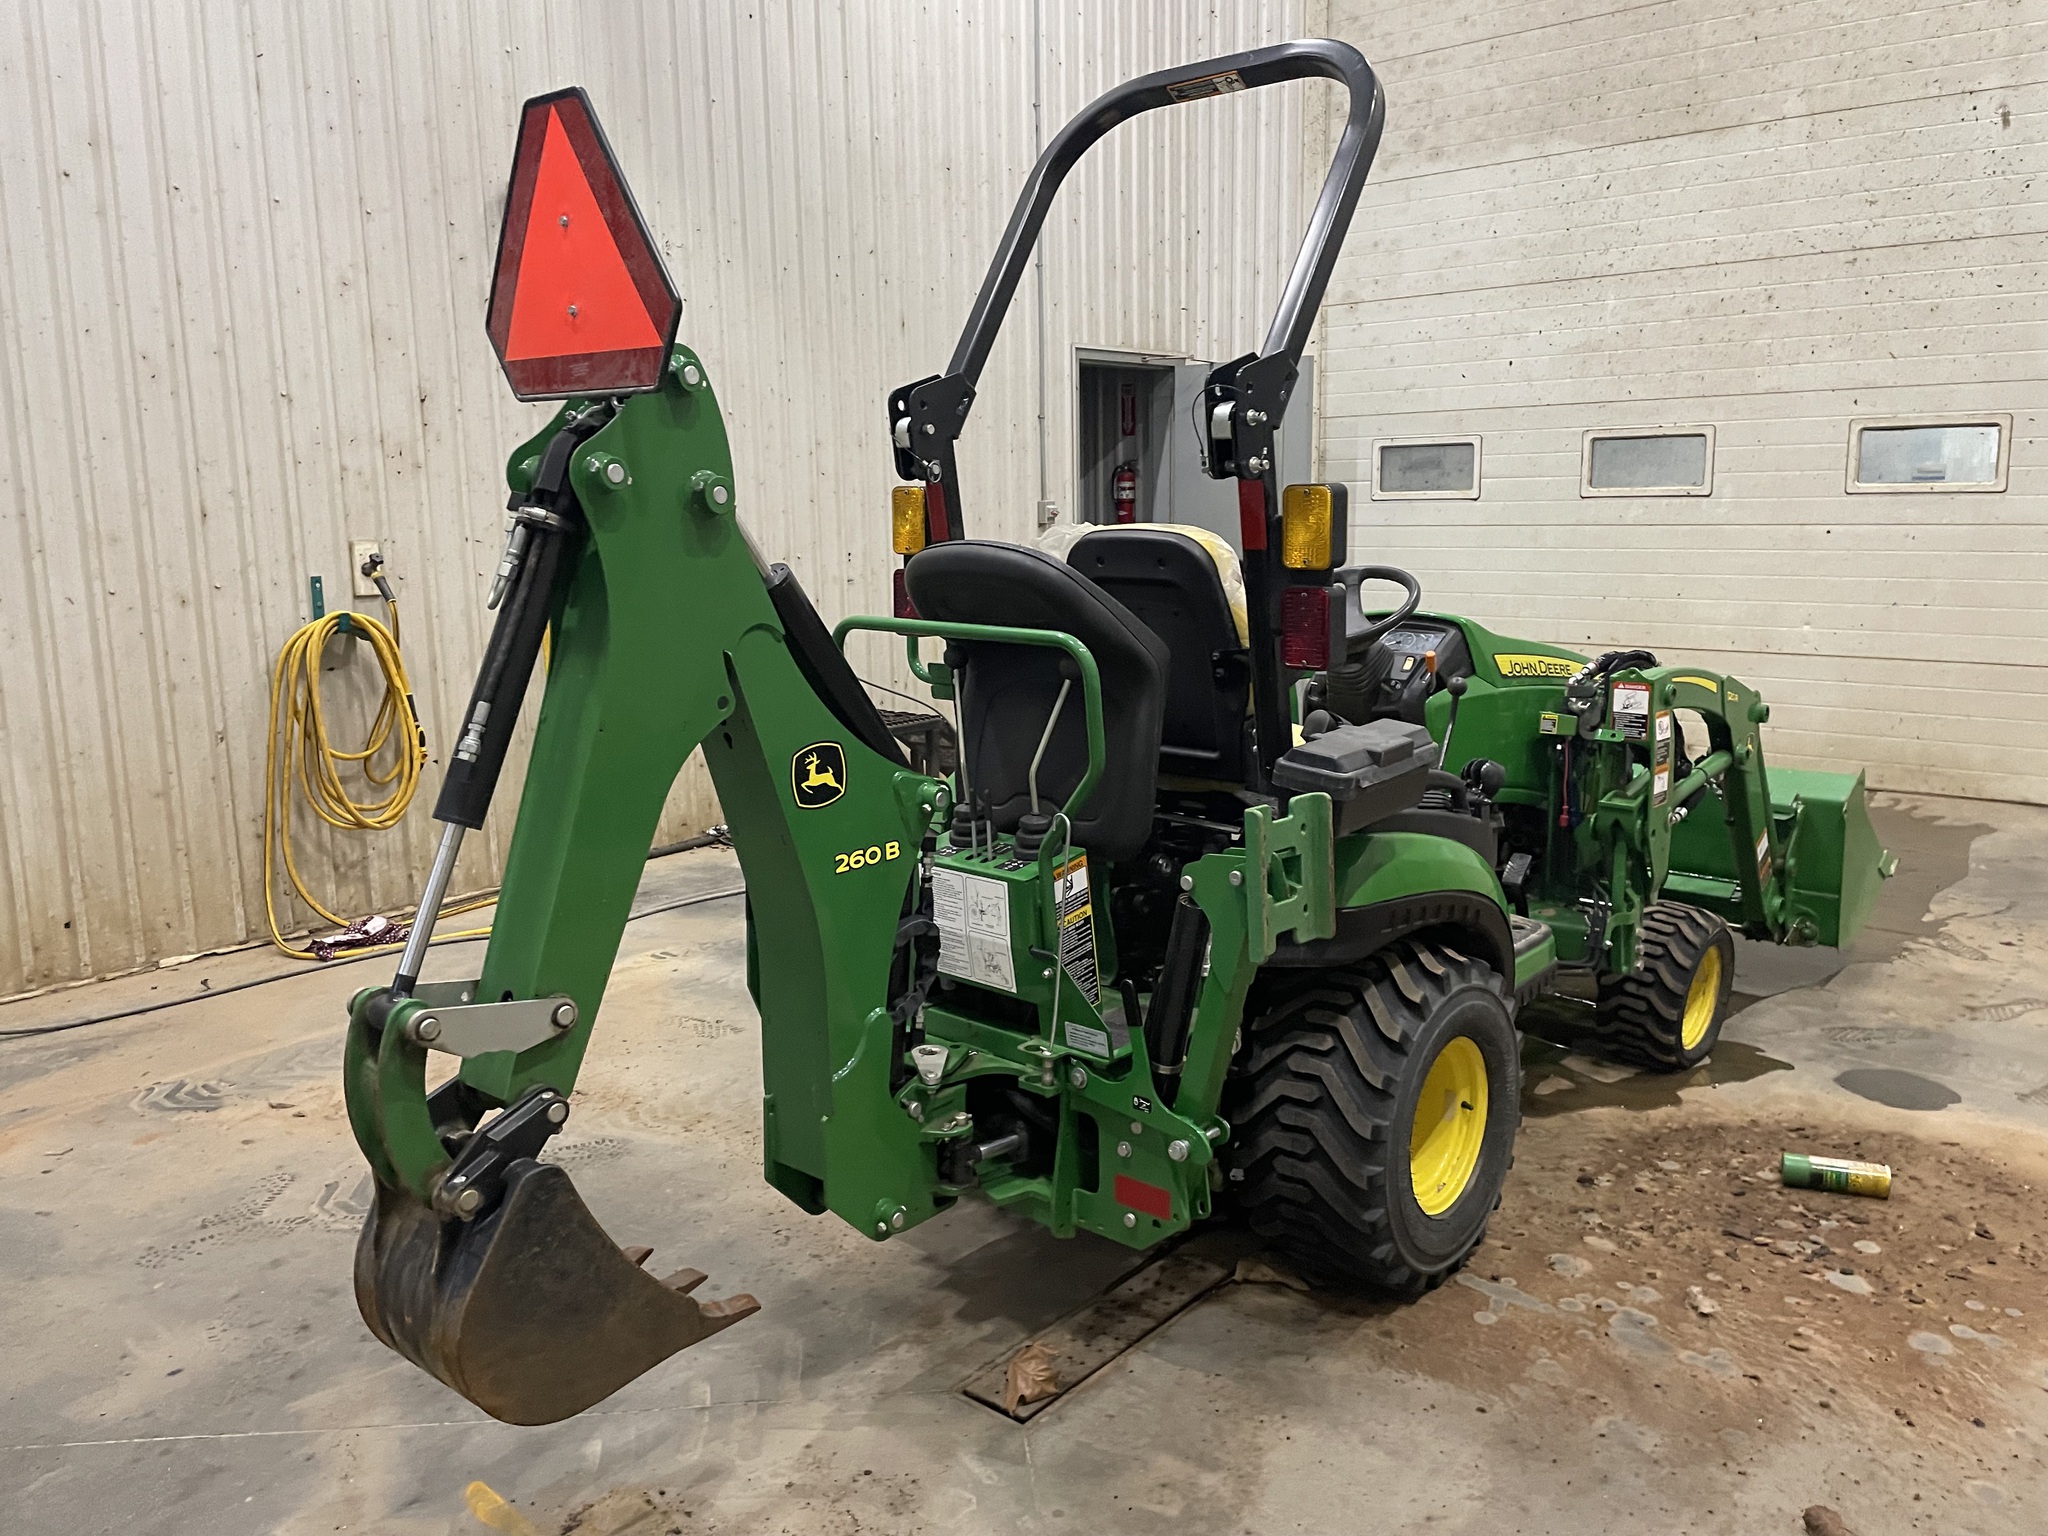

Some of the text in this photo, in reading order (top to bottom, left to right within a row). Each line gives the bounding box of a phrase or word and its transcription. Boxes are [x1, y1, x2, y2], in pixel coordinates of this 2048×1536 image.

[1508, 660, 1573, 676] JOHN DEERE
[834, 840, 901, 874] 260 B
[1056, 860, 1084, 879] WANING
[1063, 909, 1088, 927] CAUTION
